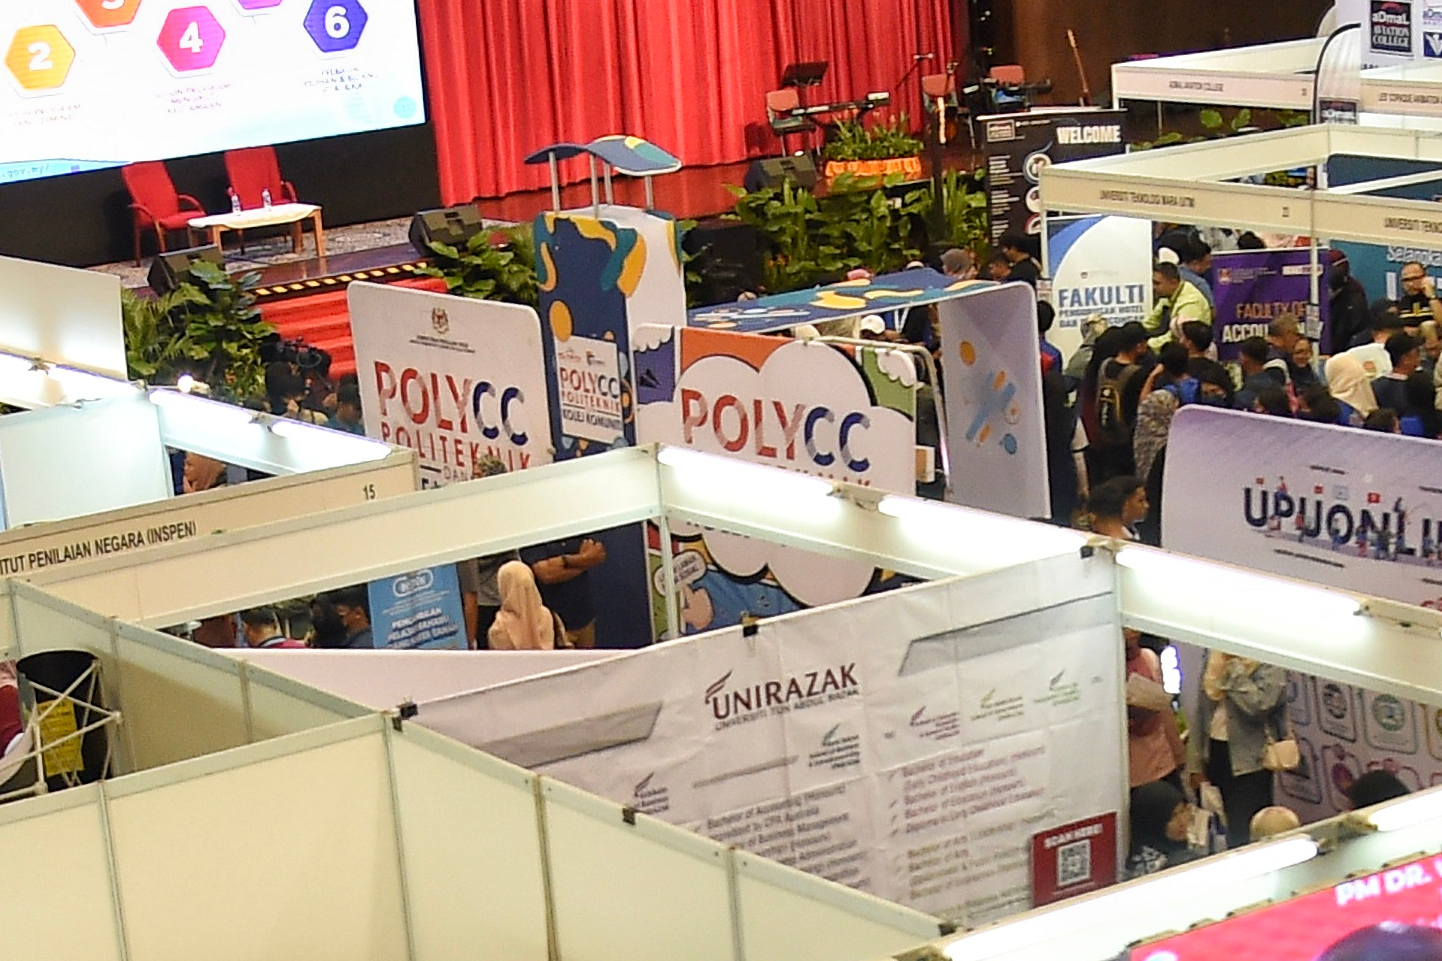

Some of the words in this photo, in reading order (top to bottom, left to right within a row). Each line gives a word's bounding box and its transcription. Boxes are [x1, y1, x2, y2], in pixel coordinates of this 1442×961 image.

[324, 5, 349, 38] 6
[1373, 26, 1410, 37] AVIATION
[179, 23, 203, 52] 4
[1373, 36, 1410, 48] COLLEGE
[28, 42, 52, 70] 2
[1057, 125, 1121, 144] WELCOME
[1384, 217, 1419, 231] UNIVERSITI
[1058, 285, 1145, 308] FAKULTI
[1109, 305, 1145, 317] HOTEL
[1237, 301, 1289, 319] FACULTY
[1293, 301, 1307, 316] OF
[559, 367, 620, 399] POLYCC
[374, 361, 529, 446] POLYCC
[561, 390, 621, 413] POLITEKNIK
[681, 388, 870, 472] POLYCC
[363, 484, 376, 500] 15
[29, 541, 91, 568] PENILAIAN
[95, 530, 144, 556] NEGARA
[147, 520, 196, 547] (INSPEN)
[711, 662, 857, 720] UNIRAZAK
[715, 711, 767, 730] UNIVERSITI
[794, 696, 824, 711] ABDUL
[828, 688, 859, 702] RAZAK
[1044, 832, 1073, 848] SCAN
[1335, 870, 1381, 907] PM
[1385, 864, 1433, 894] DR.
